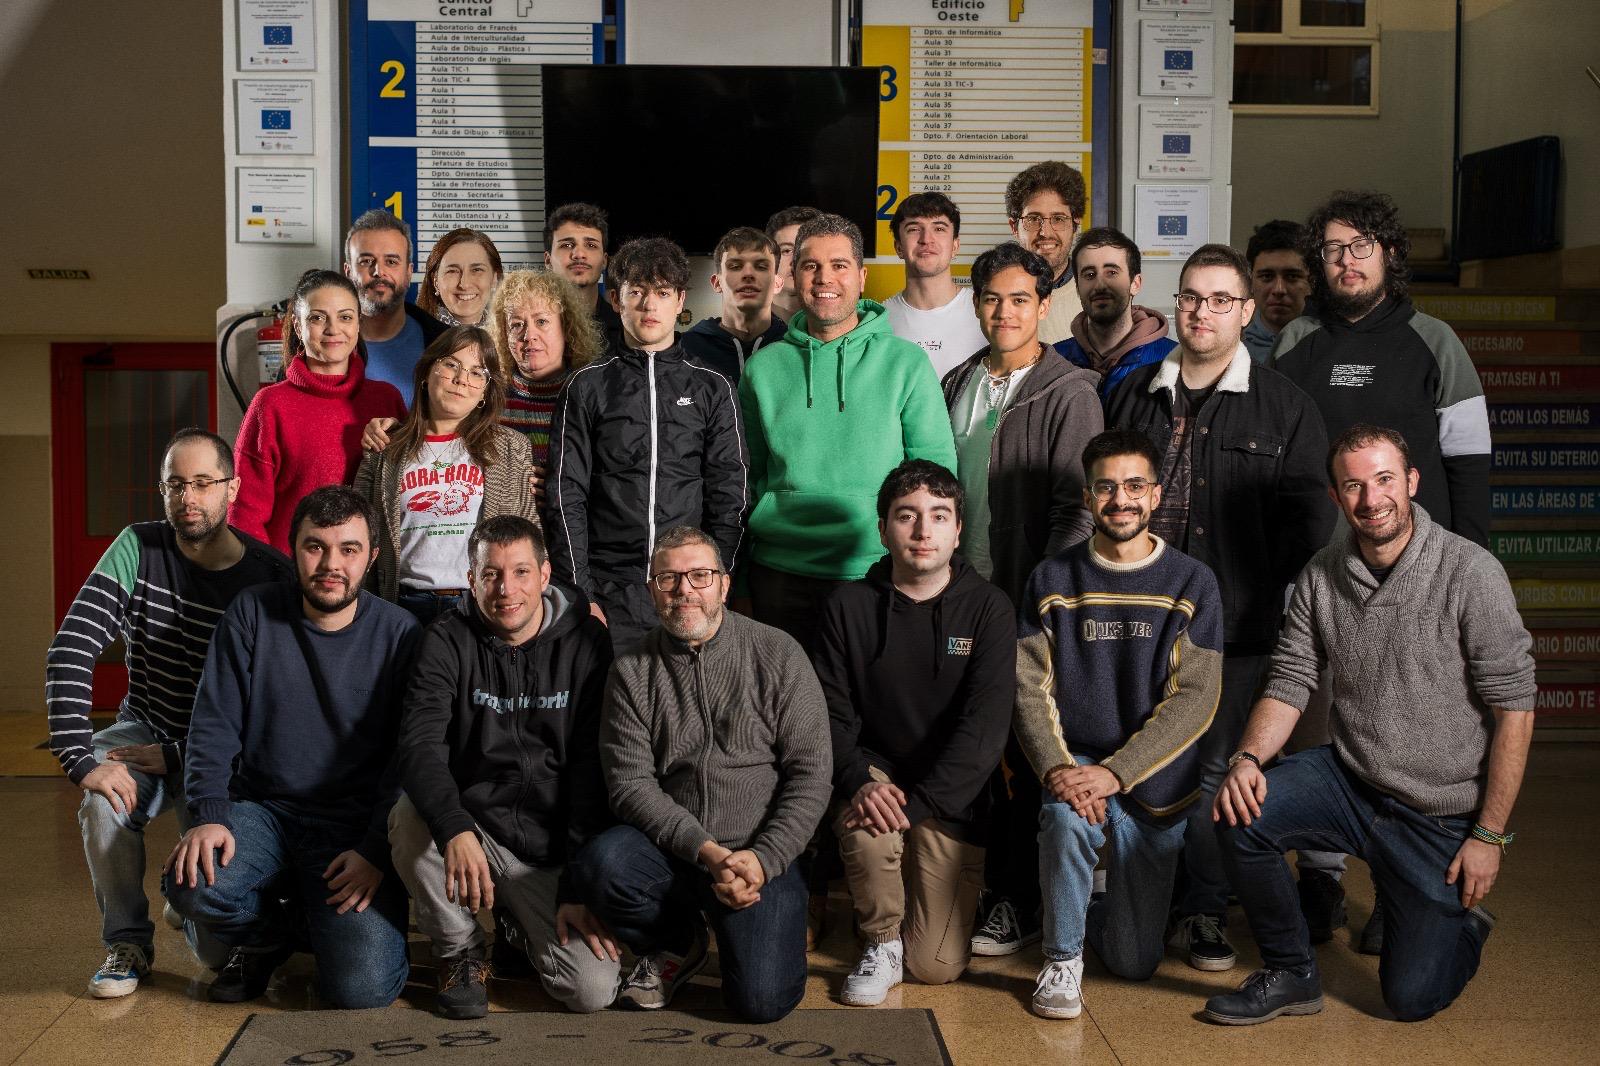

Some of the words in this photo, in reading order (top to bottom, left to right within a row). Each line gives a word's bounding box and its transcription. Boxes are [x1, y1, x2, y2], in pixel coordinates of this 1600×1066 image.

[439, 6, 492, 17] Central
[938, 11, 979, 21] Oeste
[430, 23, 476, 31] Laboratorio
[477, 23, 488, 31] de
[489, 23, 518, 31] Francés
[431, 34, 448, 42] Aula
[451, 34, 461, 42] de
[463, 34, 526, 42] Interculturalidad
[924, 29, 943, 37] Dpto.
[431, 44, 448, 52] Aula
[451, 44, 461, 52] de
[463, 44, 489, 53] Dibujo
[498, 44, 526, 52] Plástica
[430, 55, 476, 63] Laboratorio
[477, 55, 488, 63] de
[489, 55, 512, 64] Inglés
[379, 60, 406, 98] 2
[880, 65, 898, 102] 3
[924, 80, 941, 88] Aula
[943, 80, 953, 88] 33
[955, 80, 974, 88] TIC-3
[431, 86, 448, 94] Aula
[431, 128, 449, 136] Aula
[451, 128, 461, 136] de
[463, 128, 489, 137] Dibujo
[498, 128, 526, 136] Plástica
[923, 132, 944, 141] Dpto.
[946, 132, 953, 140] F.
[1001, 132, 1029, 140] Laboral
[431, 149, 466, 157] Dirección
[923, 153, 944, 161] Dpto.
[431, 191, 458, 199] Oficina
[384, 191, 403, 220] 1
[431, 202, 489, 210] Departamentos
[877, 184, 898, 220] 2
[1464, 336, 1524, 352] NECESARIO
[1481, 371, 1536, 387] TRATASEN
[1539, 372, 1548, 387] A
[1549, 371, 1560, 387] TI
[1500, 409, 1524, 425] CON
[1527, 409, 1549, 425] LOS
[1552, 406, 1590, 425] DEMÁS
[1495, 451, 1528, 467] EVITA
[1531, 451, 1547, 467] SU
[1550, 450, 1600, 467] DETERIO
[1492, 492, 1509, 508] EN
[1512, 492, 1534, 508] LAS
[1537, 489, 1577, 508] ÁREAS
[1579, 491, 1595, 508] DE
[1498, 538, 1533, 554] EVITA
[1536, 537, 1593, 553] UTILIZAR
[1515, 586, 1556, 602] ORDES
[1560, 585, 1586, 602] CON
[948, 637, 973, 650] VANS
[1535, 689, 1575, 708] ANDO
[1578, 689, 1596, 708] TE
